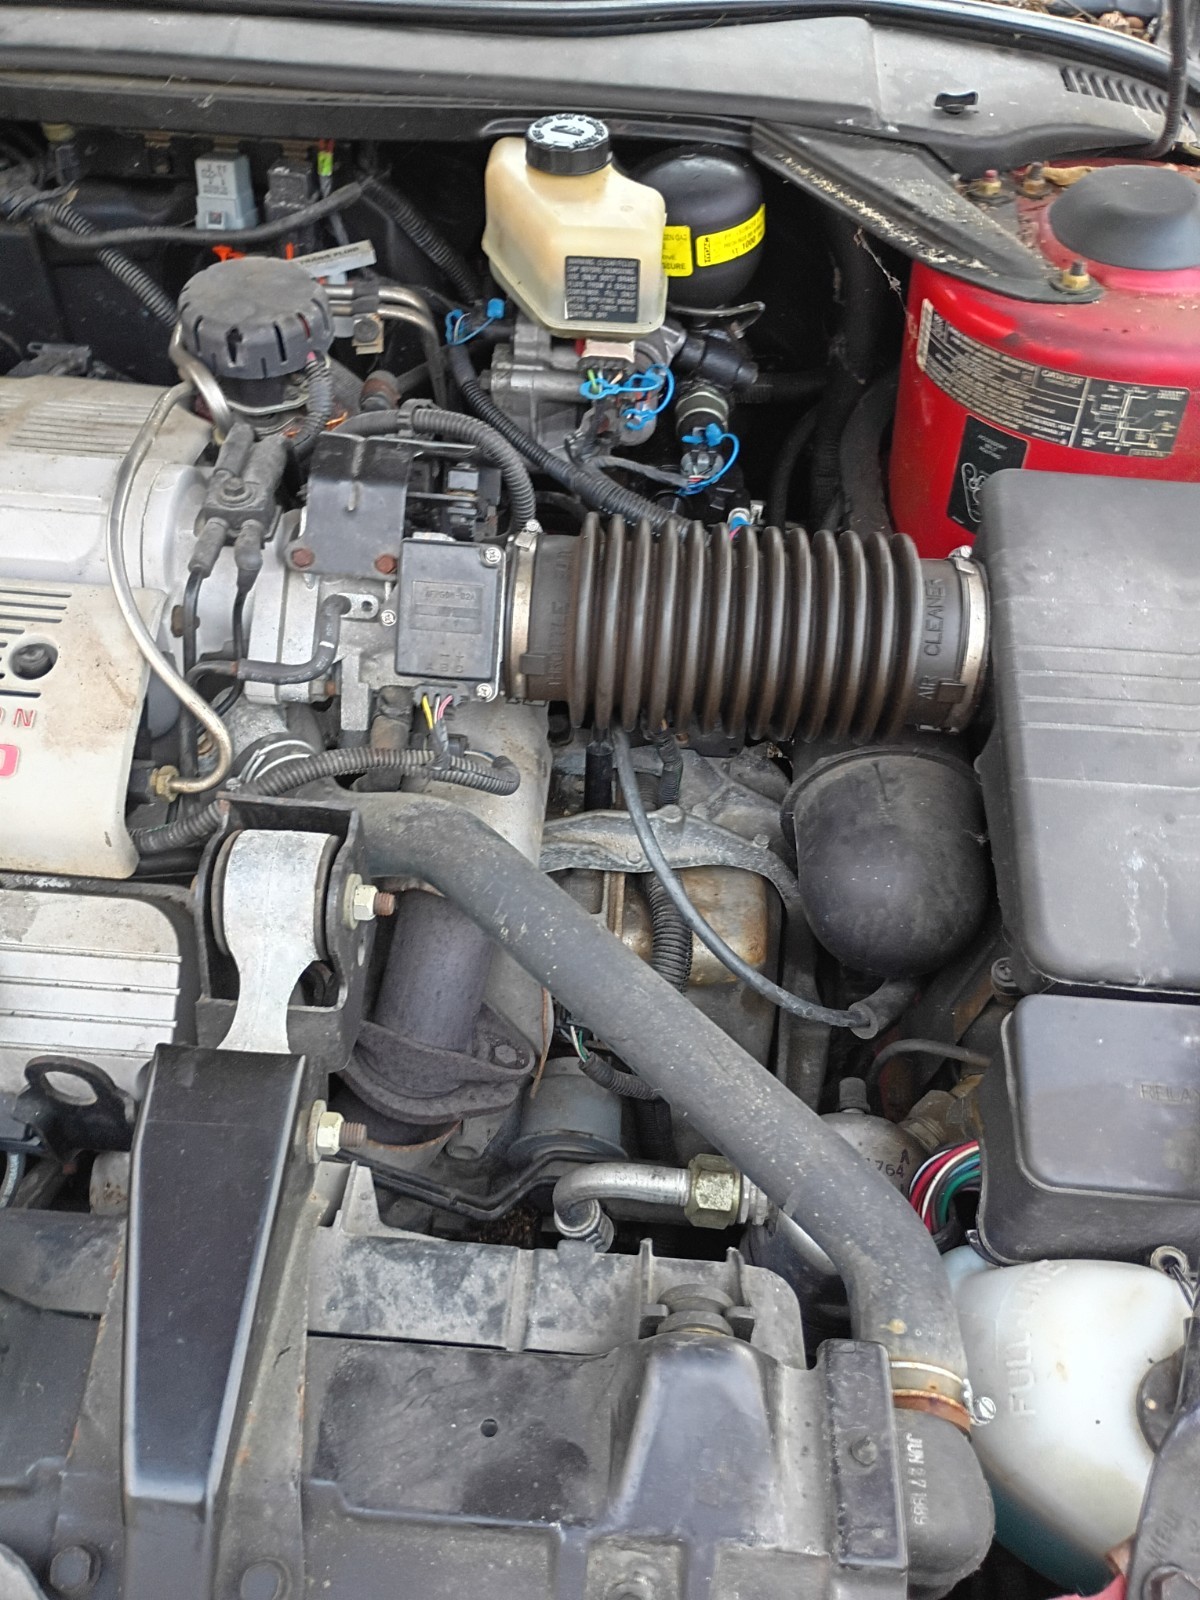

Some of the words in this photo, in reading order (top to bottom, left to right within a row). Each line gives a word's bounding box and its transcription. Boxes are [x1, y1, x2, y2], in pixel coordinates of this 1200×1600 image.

[923, 578, 947, 657] CLEANER
[868, 1158, 904, 1178] 764
[1004, 1330, 1037, 1416] FULL
[905, 1432, 925, 1465] JUN
